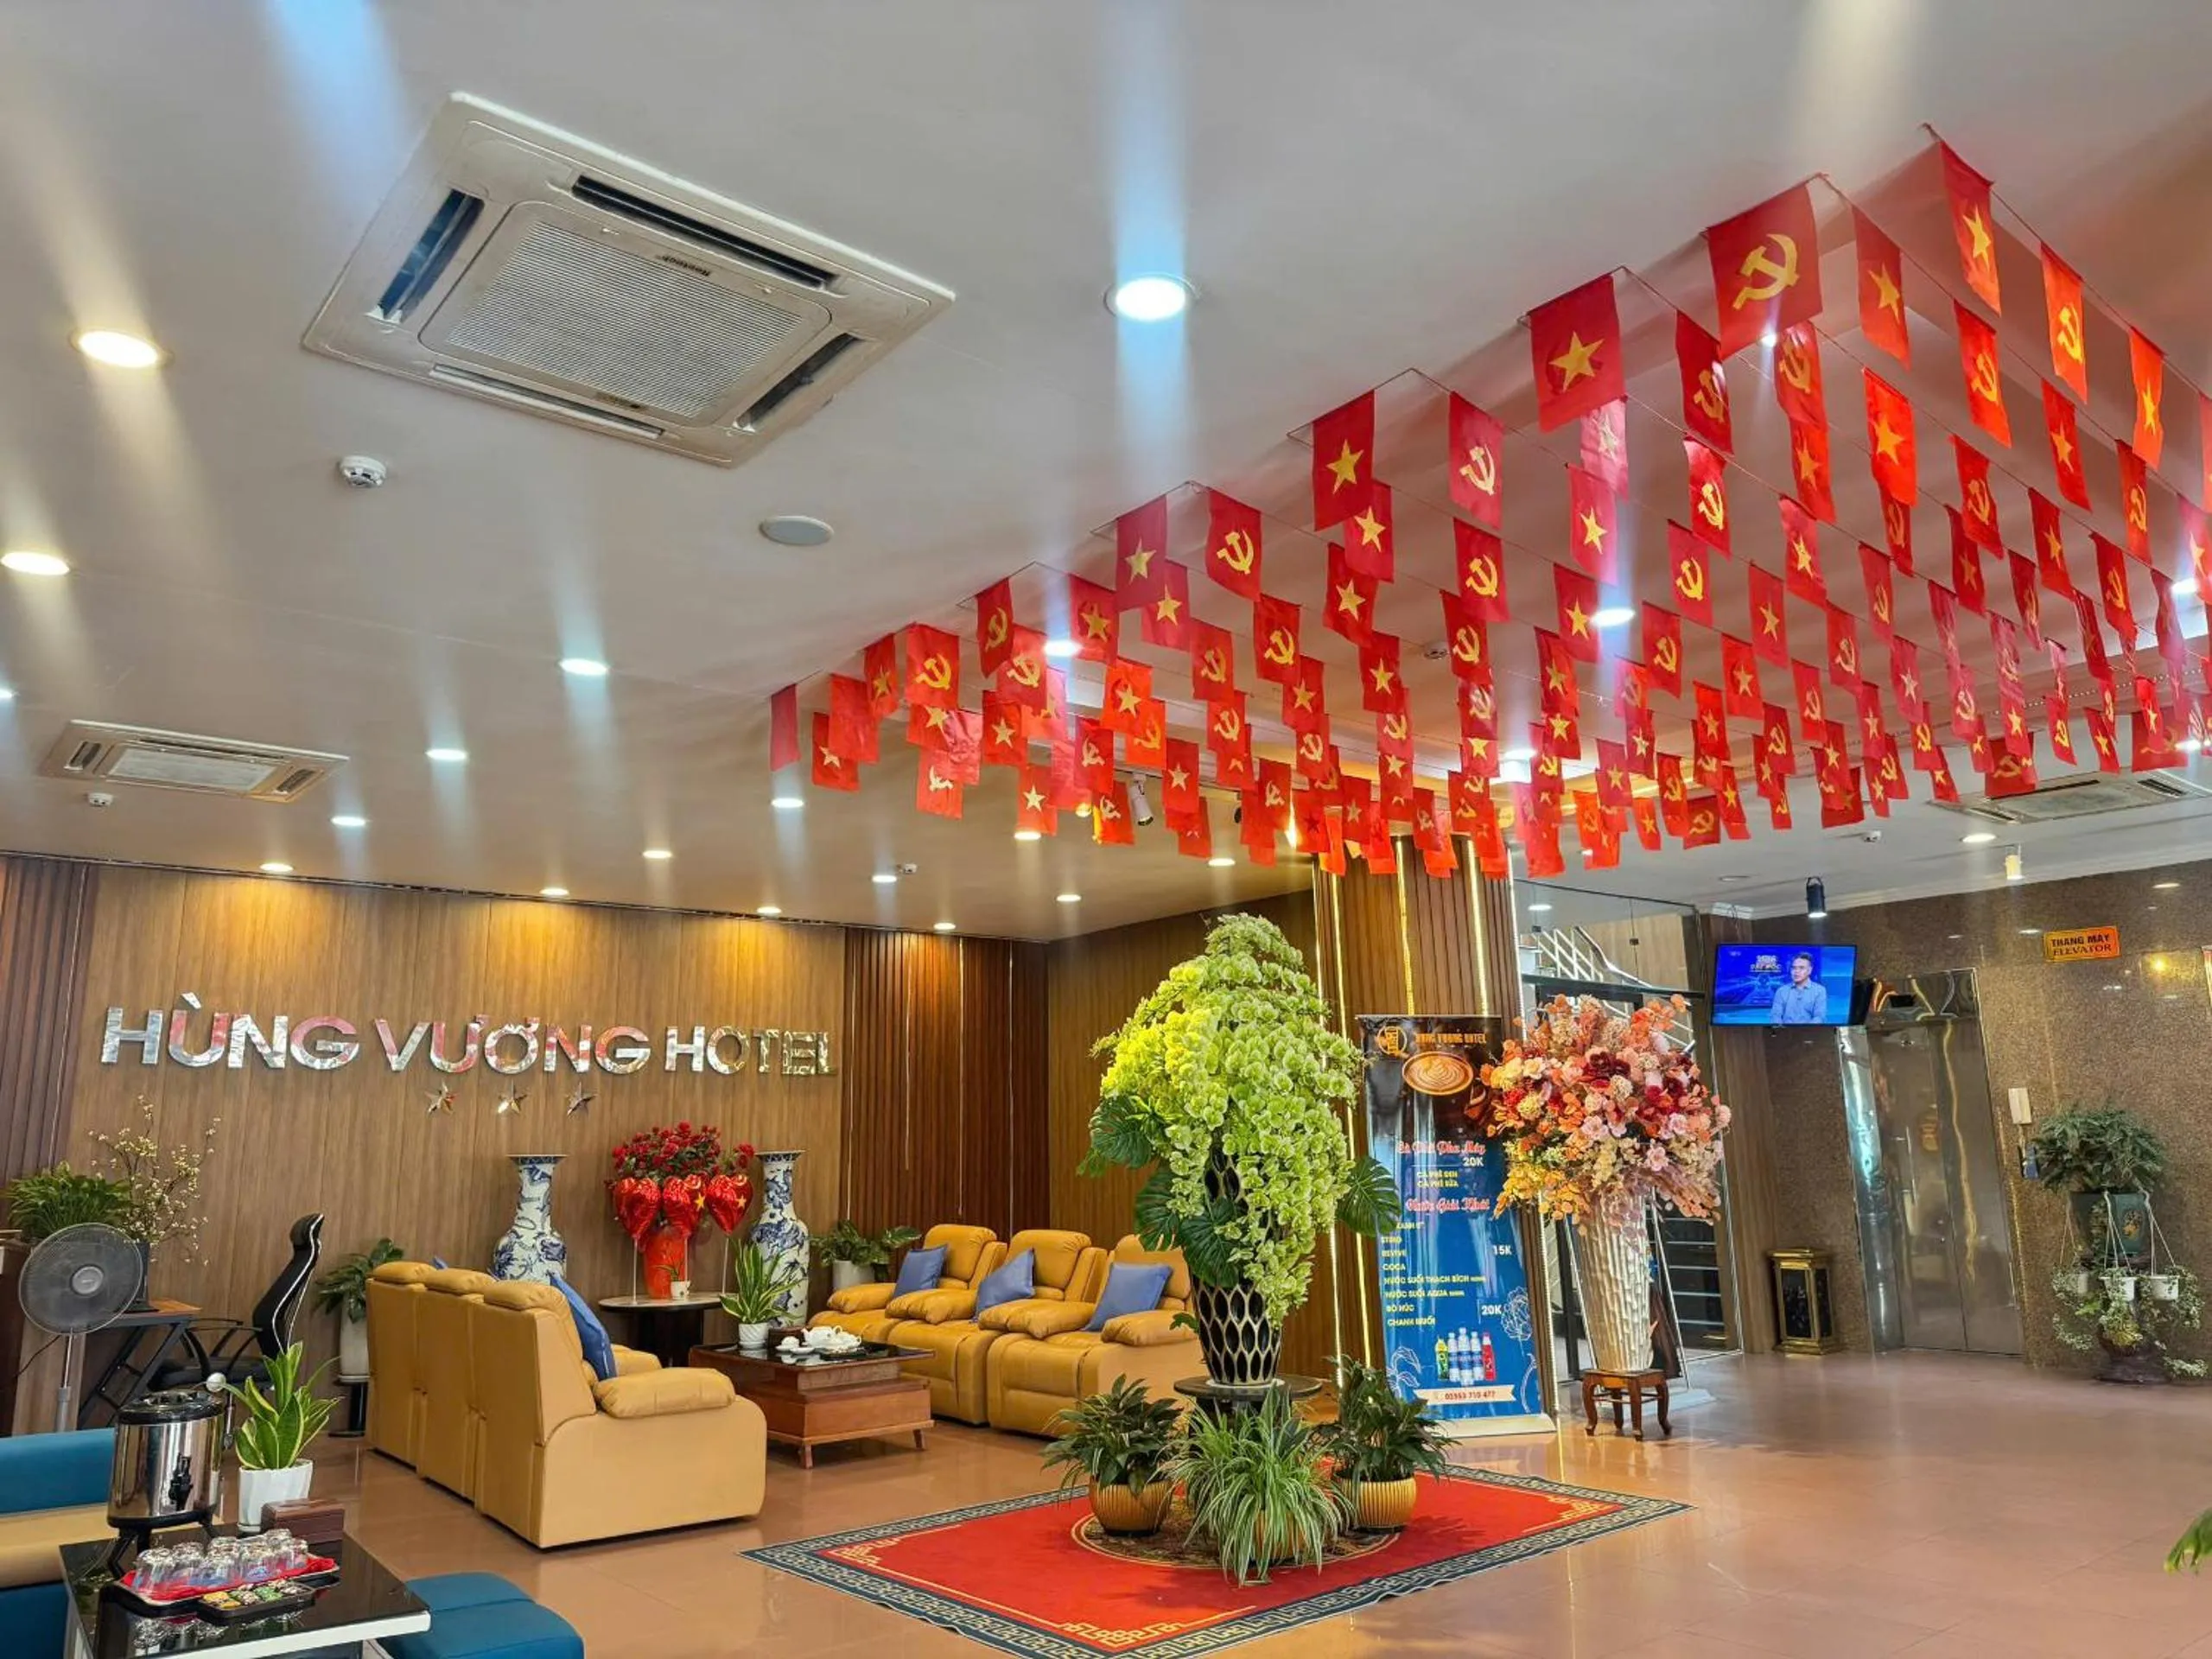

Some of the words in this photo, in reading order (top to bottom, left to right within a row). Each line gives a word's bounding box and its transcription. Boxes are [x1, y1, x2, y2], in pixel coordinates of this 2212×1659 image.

[2053, 944, 2111, 956] ELEVATOR
[100, 991, 360, 1071] HÙNG
[373, 1014, 652, 1075] VƯƠNG
[664, 1025, 838, 1077] HOTEL
[1462, 1157, 1484, 1166] 20K
[1493, 1244, 1512, 1255] 15K
[1481, 1304, 1502, 1316] 20K
